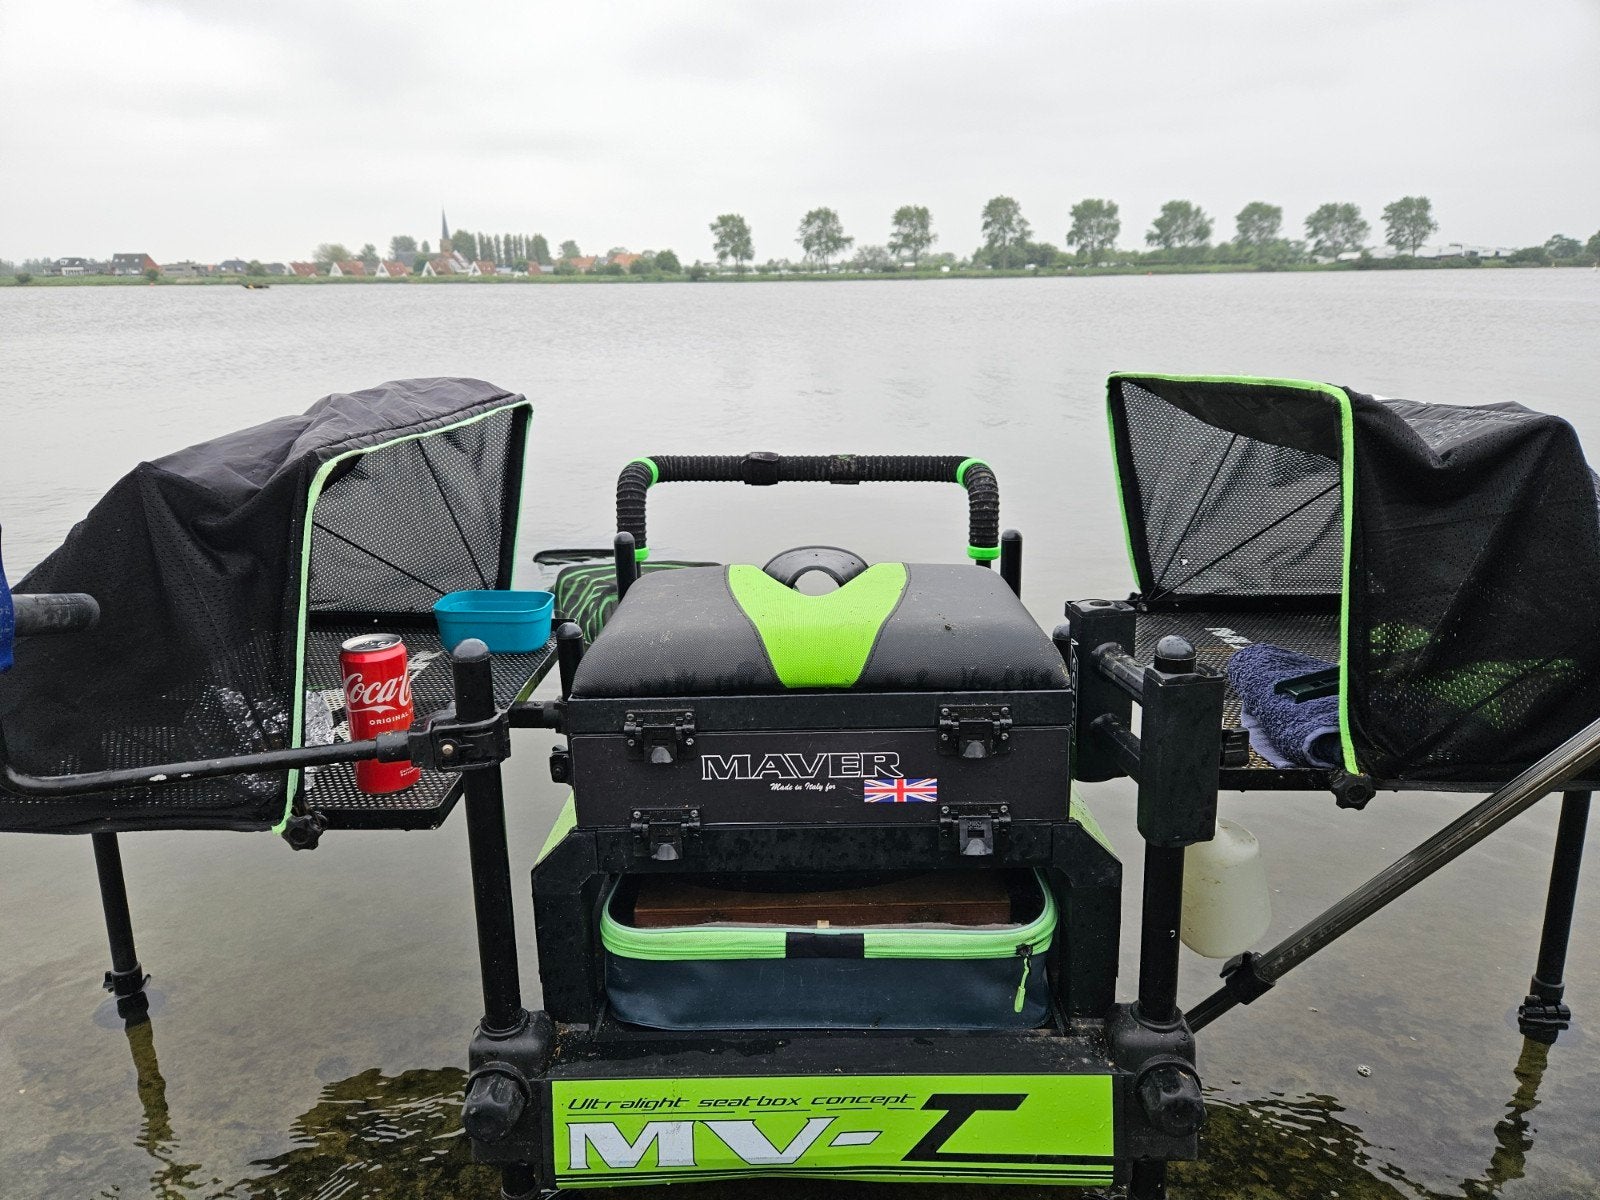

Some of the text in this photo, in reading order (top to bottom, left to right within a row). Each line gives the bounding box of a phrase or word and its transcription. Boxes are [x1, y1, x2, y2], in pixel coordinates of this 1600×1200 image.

[369, 711, 409, 726] ORIGINAL
[701, 752, 904, 780] MAVER
[769, 782, 793, 791] Made
[804, 781, 824, 792] Italy
[824, 782, 836, 793] for
[567, 1097, 690, 1112] Ultralight
[811, 1093, 917, 1106] concept
